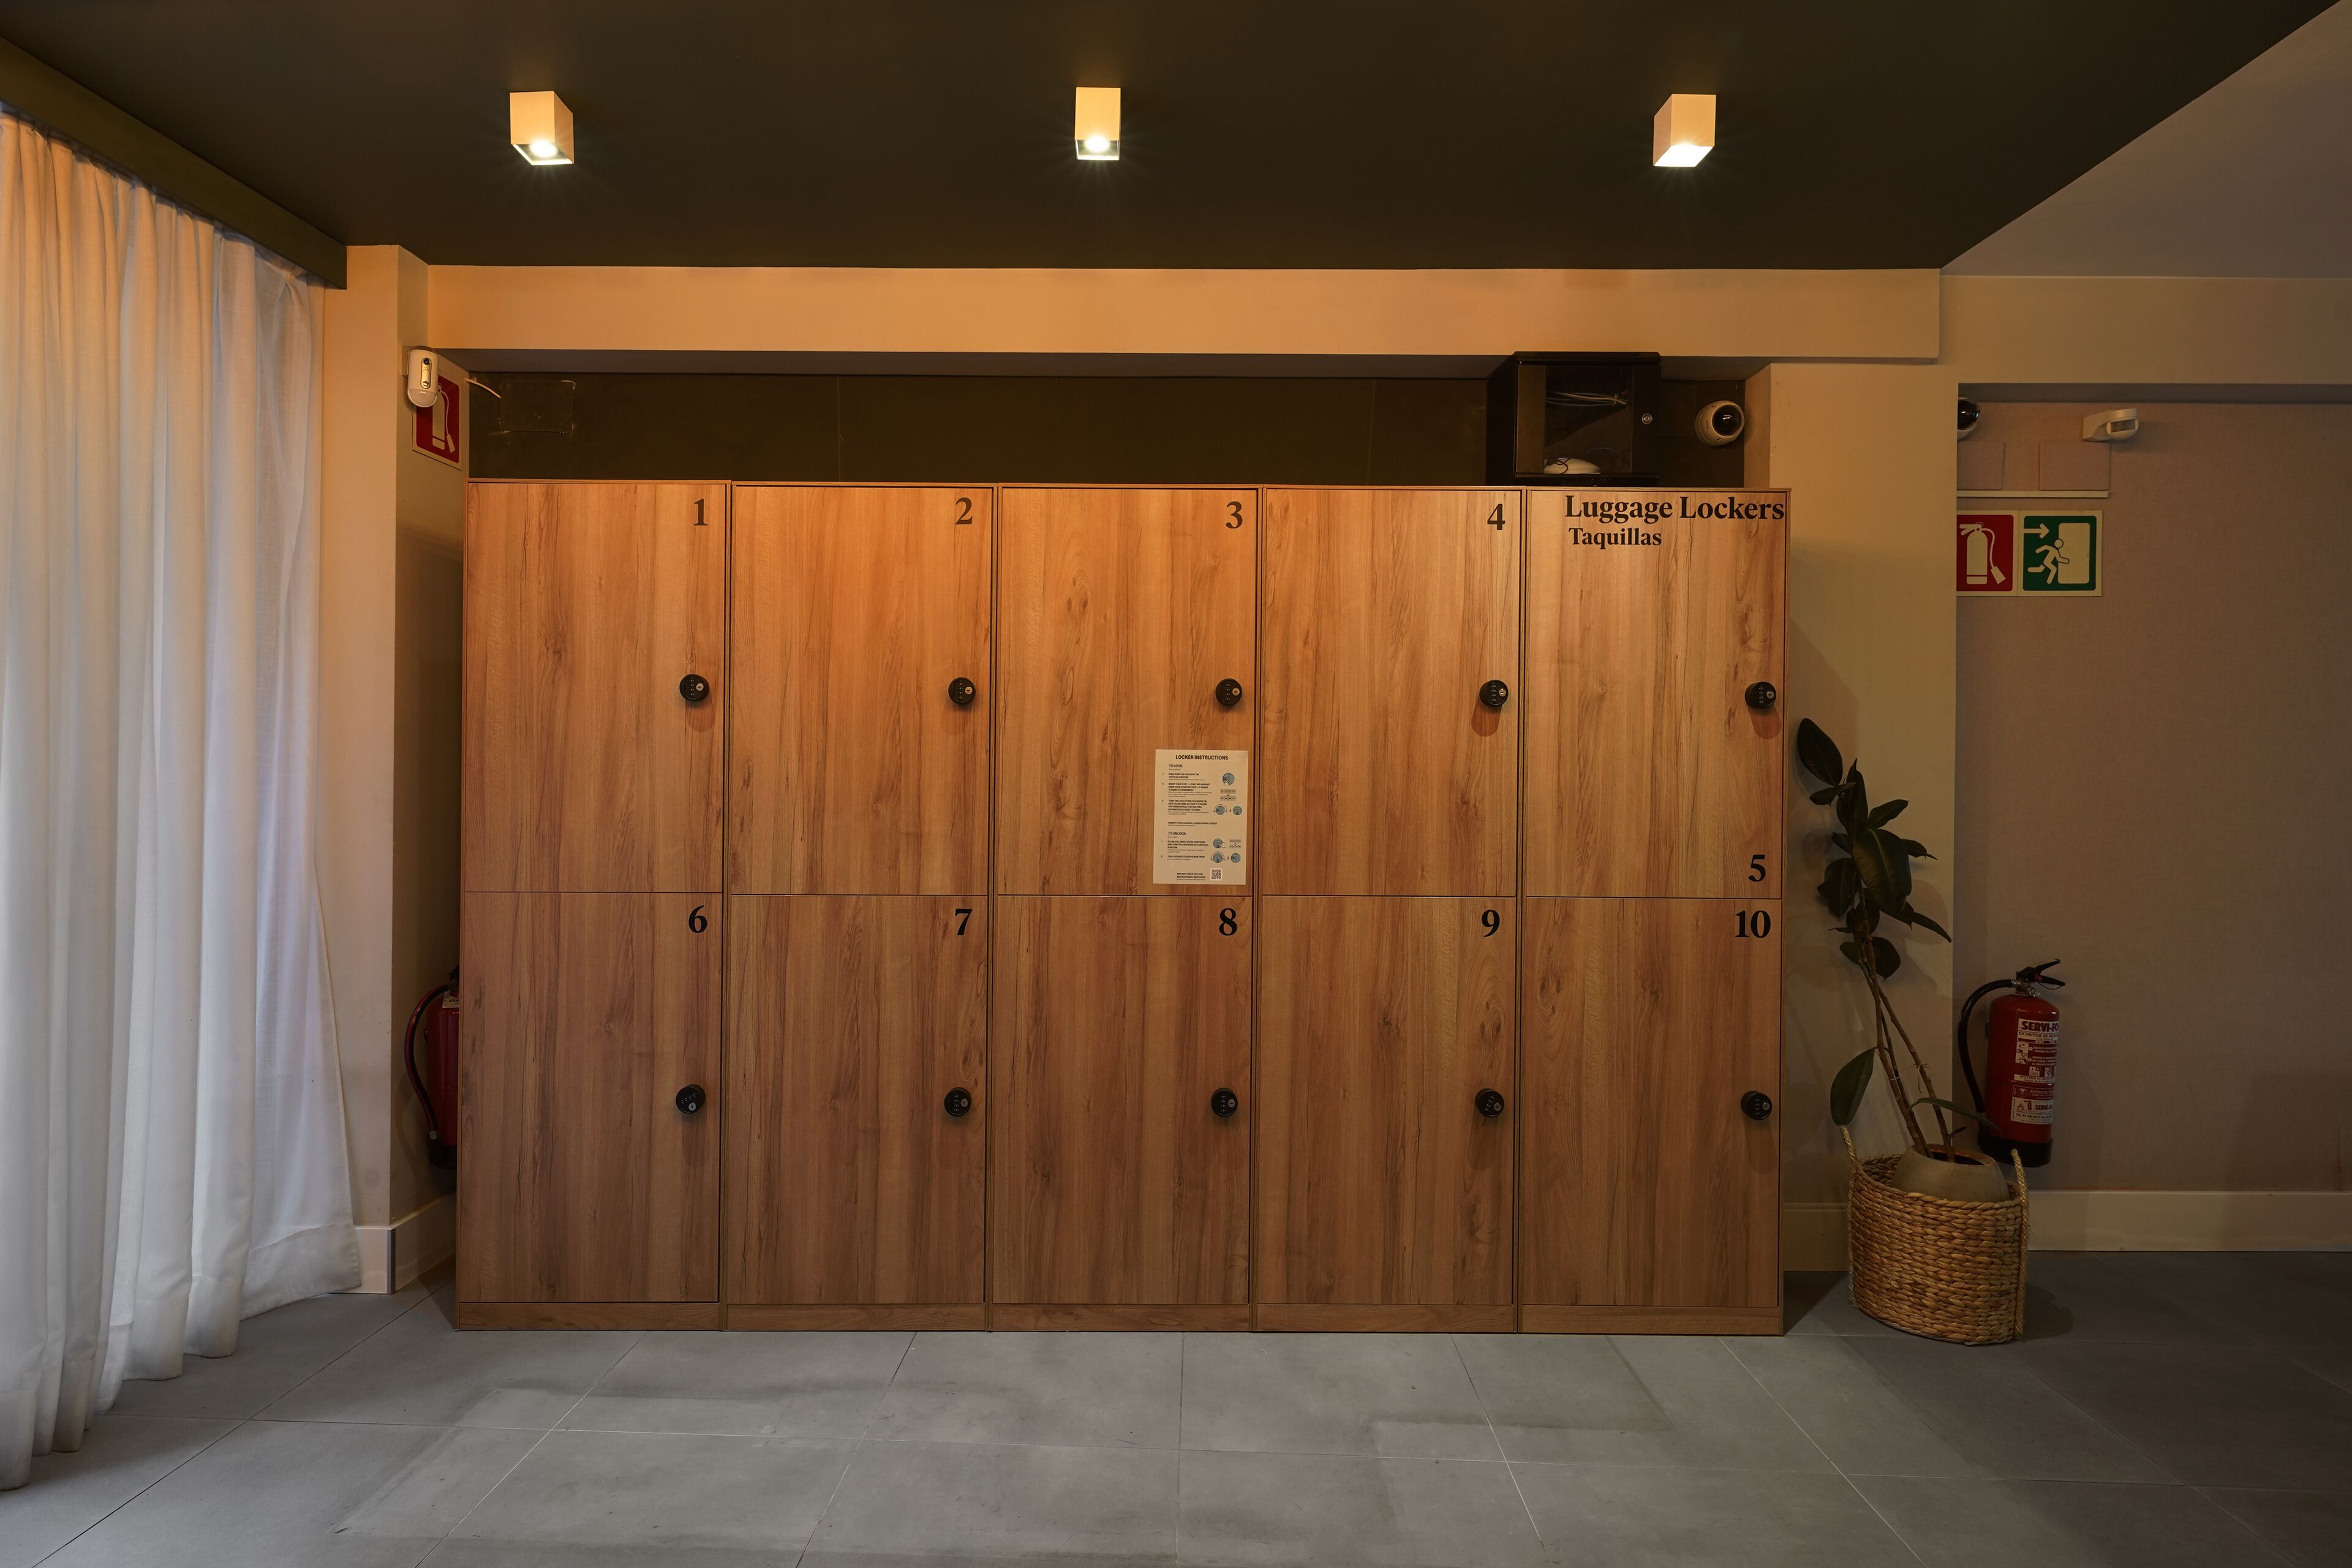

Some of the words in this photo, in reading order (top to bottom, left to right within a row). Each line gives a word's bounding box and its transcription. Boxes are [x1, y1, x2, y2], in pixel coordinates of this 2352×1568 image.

[693, 499, 708, 526] 1
[955, 497, 973, 525] 2
[1225, 501, 1243, 529] 3
[1487, 503, 1506, 530] 4
[1565, 495, 1673, 524] Luggage
[1679, 496, 1784, 520] Lockers
[1568, 527, 1662, 550] Taquillas
[1747, 854, 1766, 883] 5
[688, 905, 708, 933] 6
[955, 908, 973, 936] 7
[1218, 908, 1238, 937] 8
[1481, 910, 1500, 938] 9
[1735, 910, 1771, 938] 10
